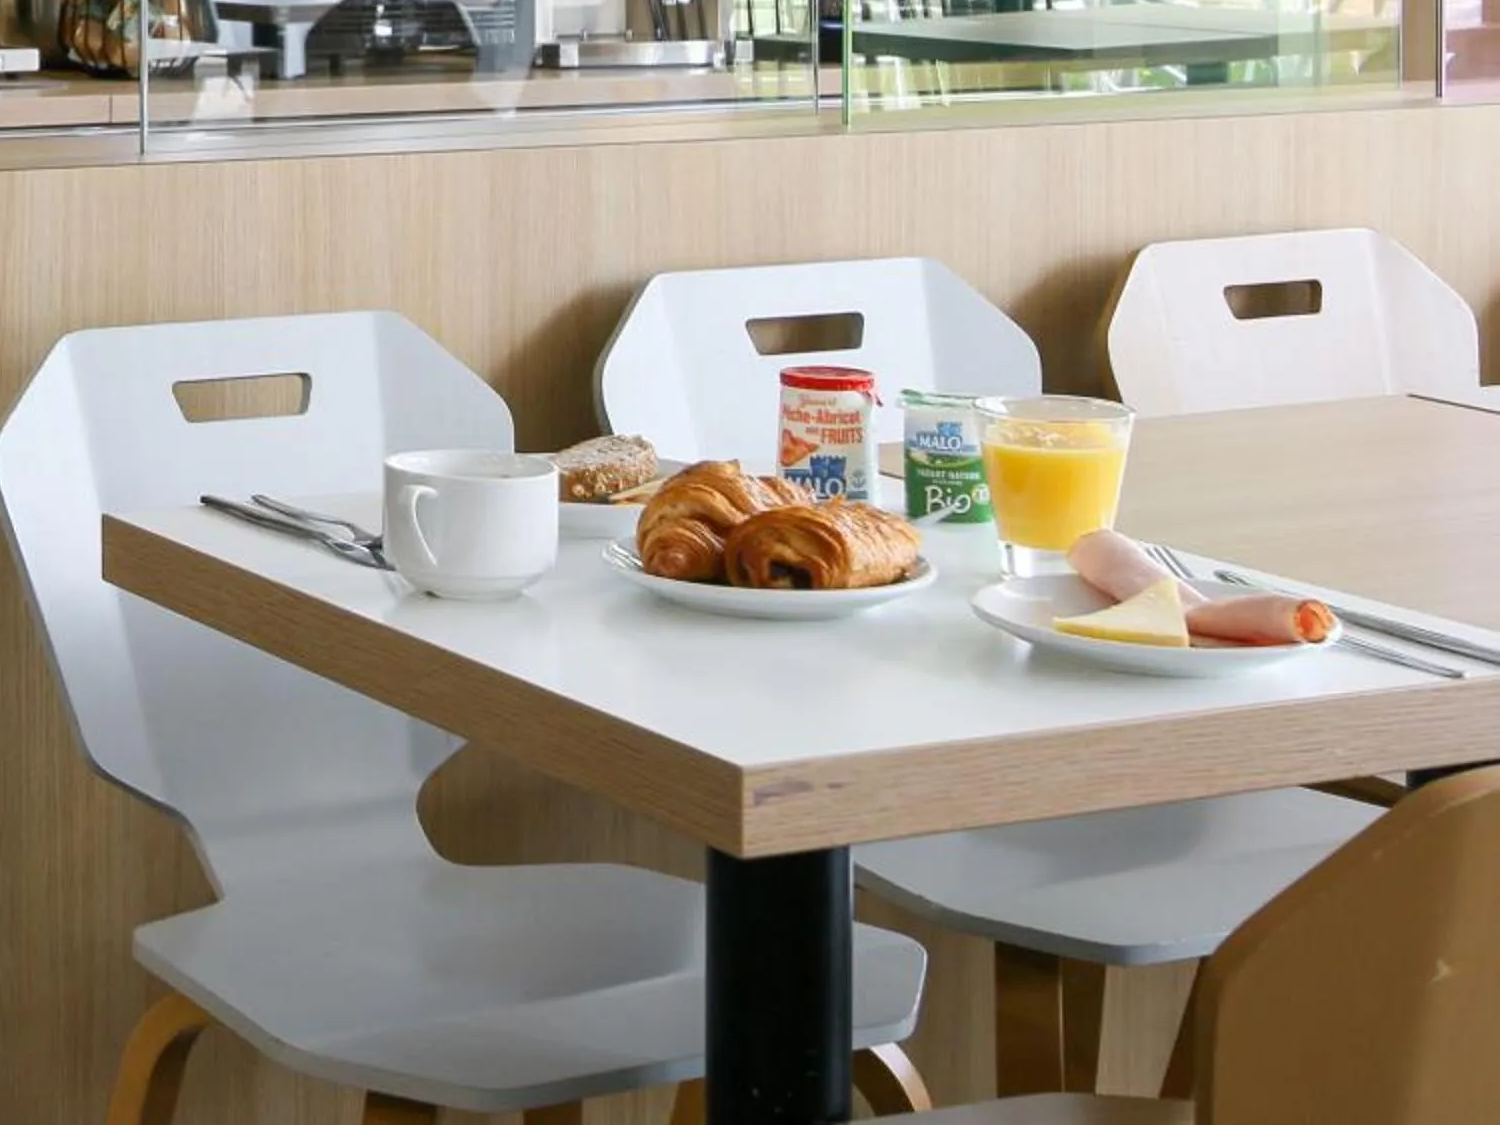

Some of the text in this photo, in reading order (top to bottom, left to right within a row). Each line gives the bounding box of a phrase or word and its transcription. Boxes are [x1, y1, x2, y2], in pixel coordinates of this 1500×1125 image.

[821, 427, 864, 445] FRUITS
[917, 434, 961, 450] MALO
[924, 485, 971, 516] Bio
